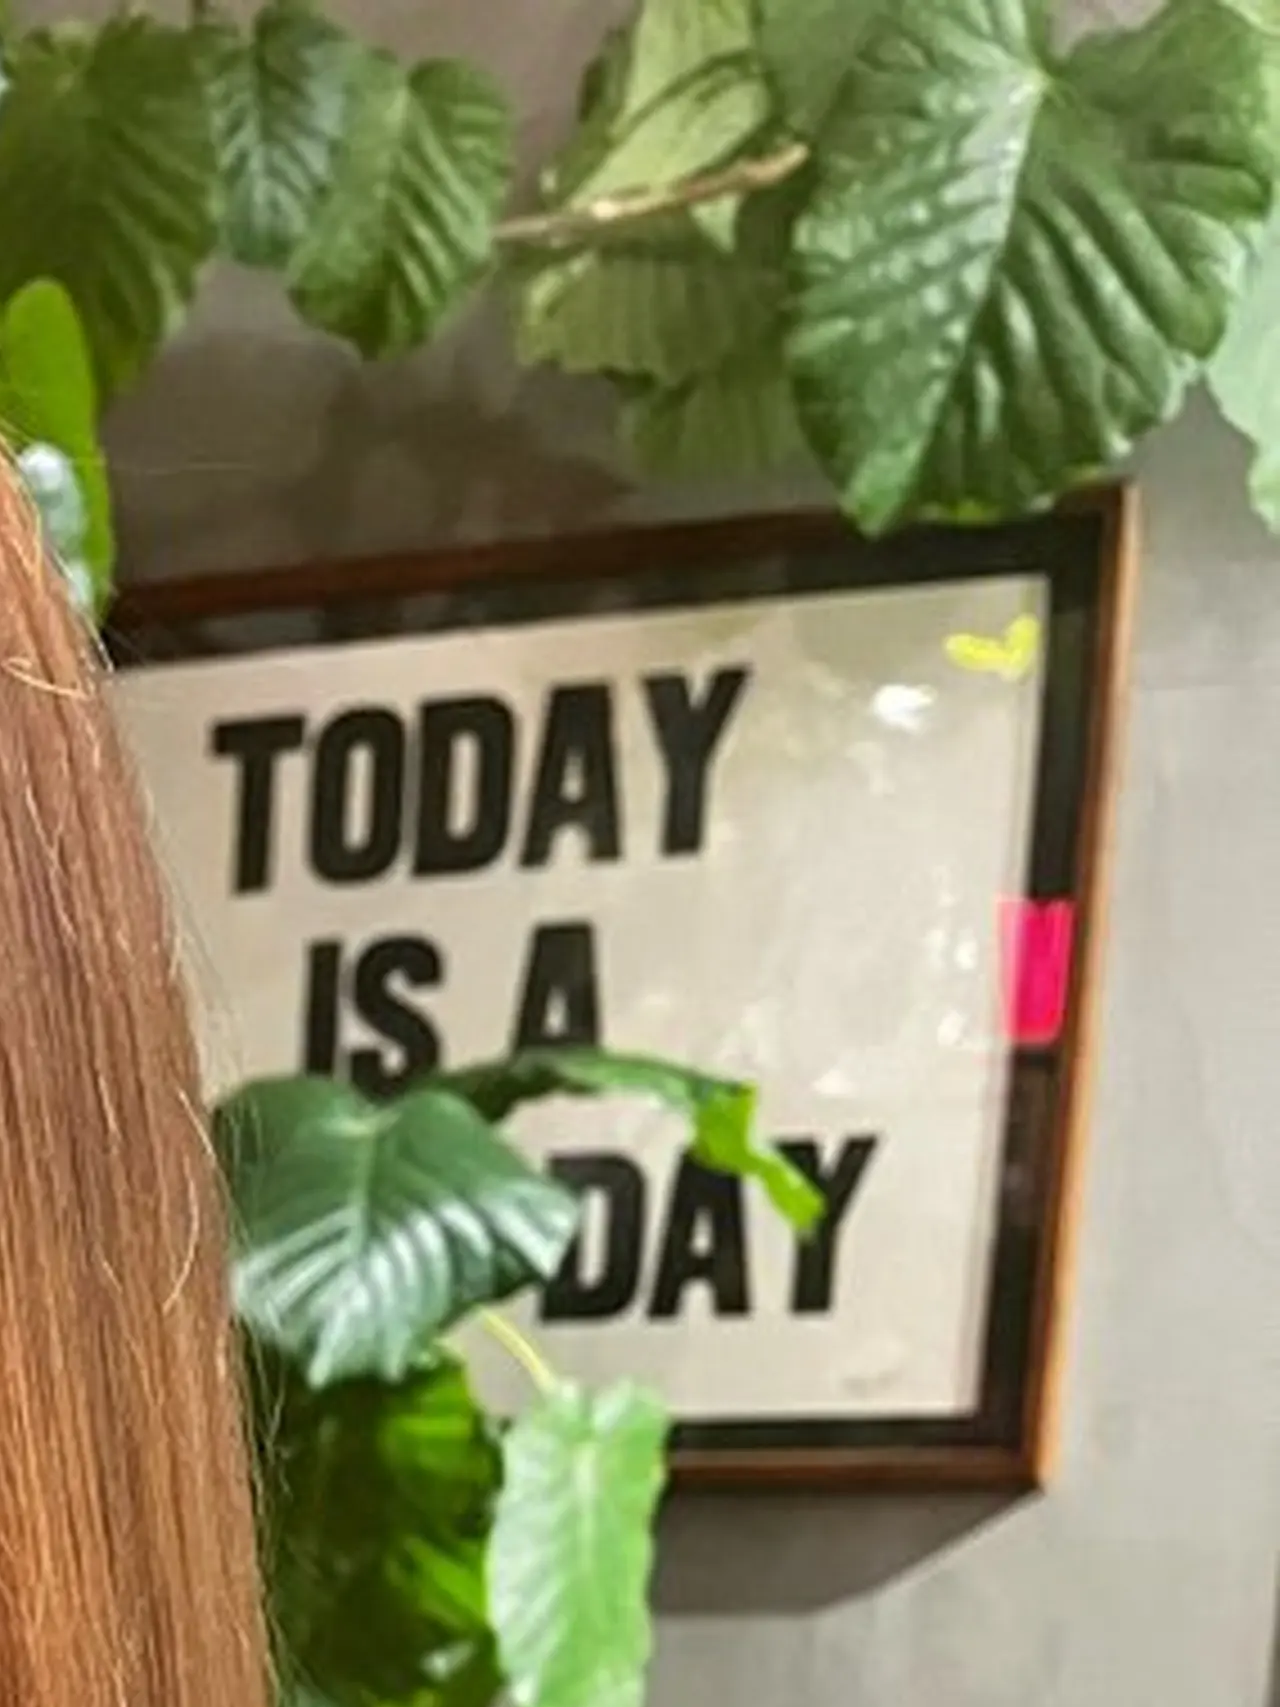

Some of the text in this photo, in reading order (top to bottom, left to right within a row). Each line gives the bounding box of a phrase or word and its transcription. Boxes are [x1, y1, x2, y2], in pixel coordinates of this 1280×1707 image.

[211, 664, 750, 896] TODAY
[302, 920, 603, 1098] IS A
[538, 1136, 878, 1326] DAY
